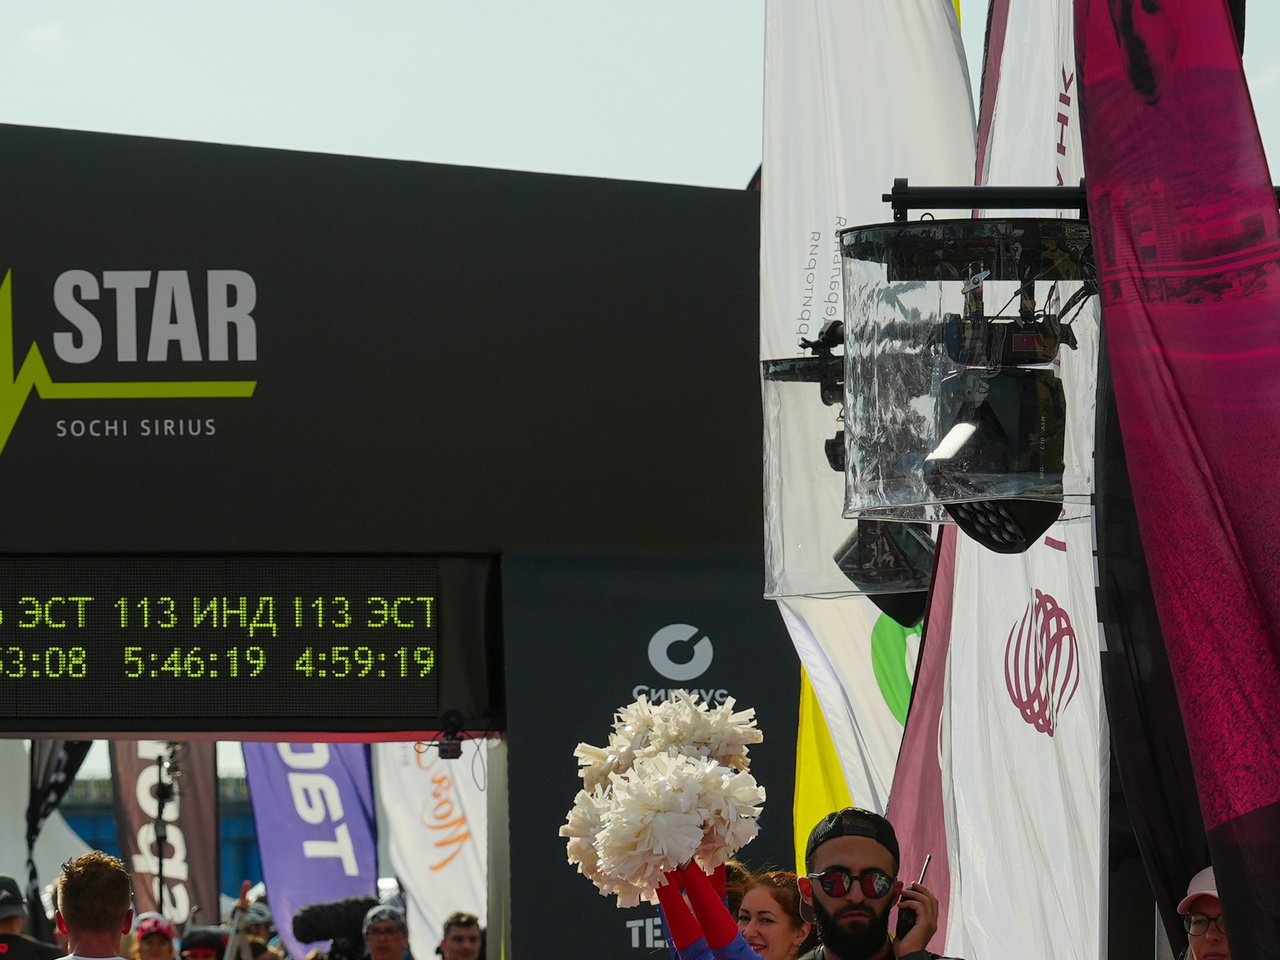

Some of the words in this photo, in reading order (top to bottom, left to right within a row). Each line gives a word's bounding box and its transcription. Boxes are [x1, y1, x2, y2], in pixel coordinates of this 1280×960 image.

[53, 269, 257, 364] STAR
[56, 419, 128, 437] SOCHI
[140, 418, 217, 436] SIRIUS
[18, 596, 94, 627] ЭСТ
[114, 596, 177, 627] 113
[193, 596, 279, 637] ИНД
[367, 596, 435, 627] ЭСТ
[124, 646, 267, 678] 5:46:19
[295, 646, 435, 678] 4:59:19
